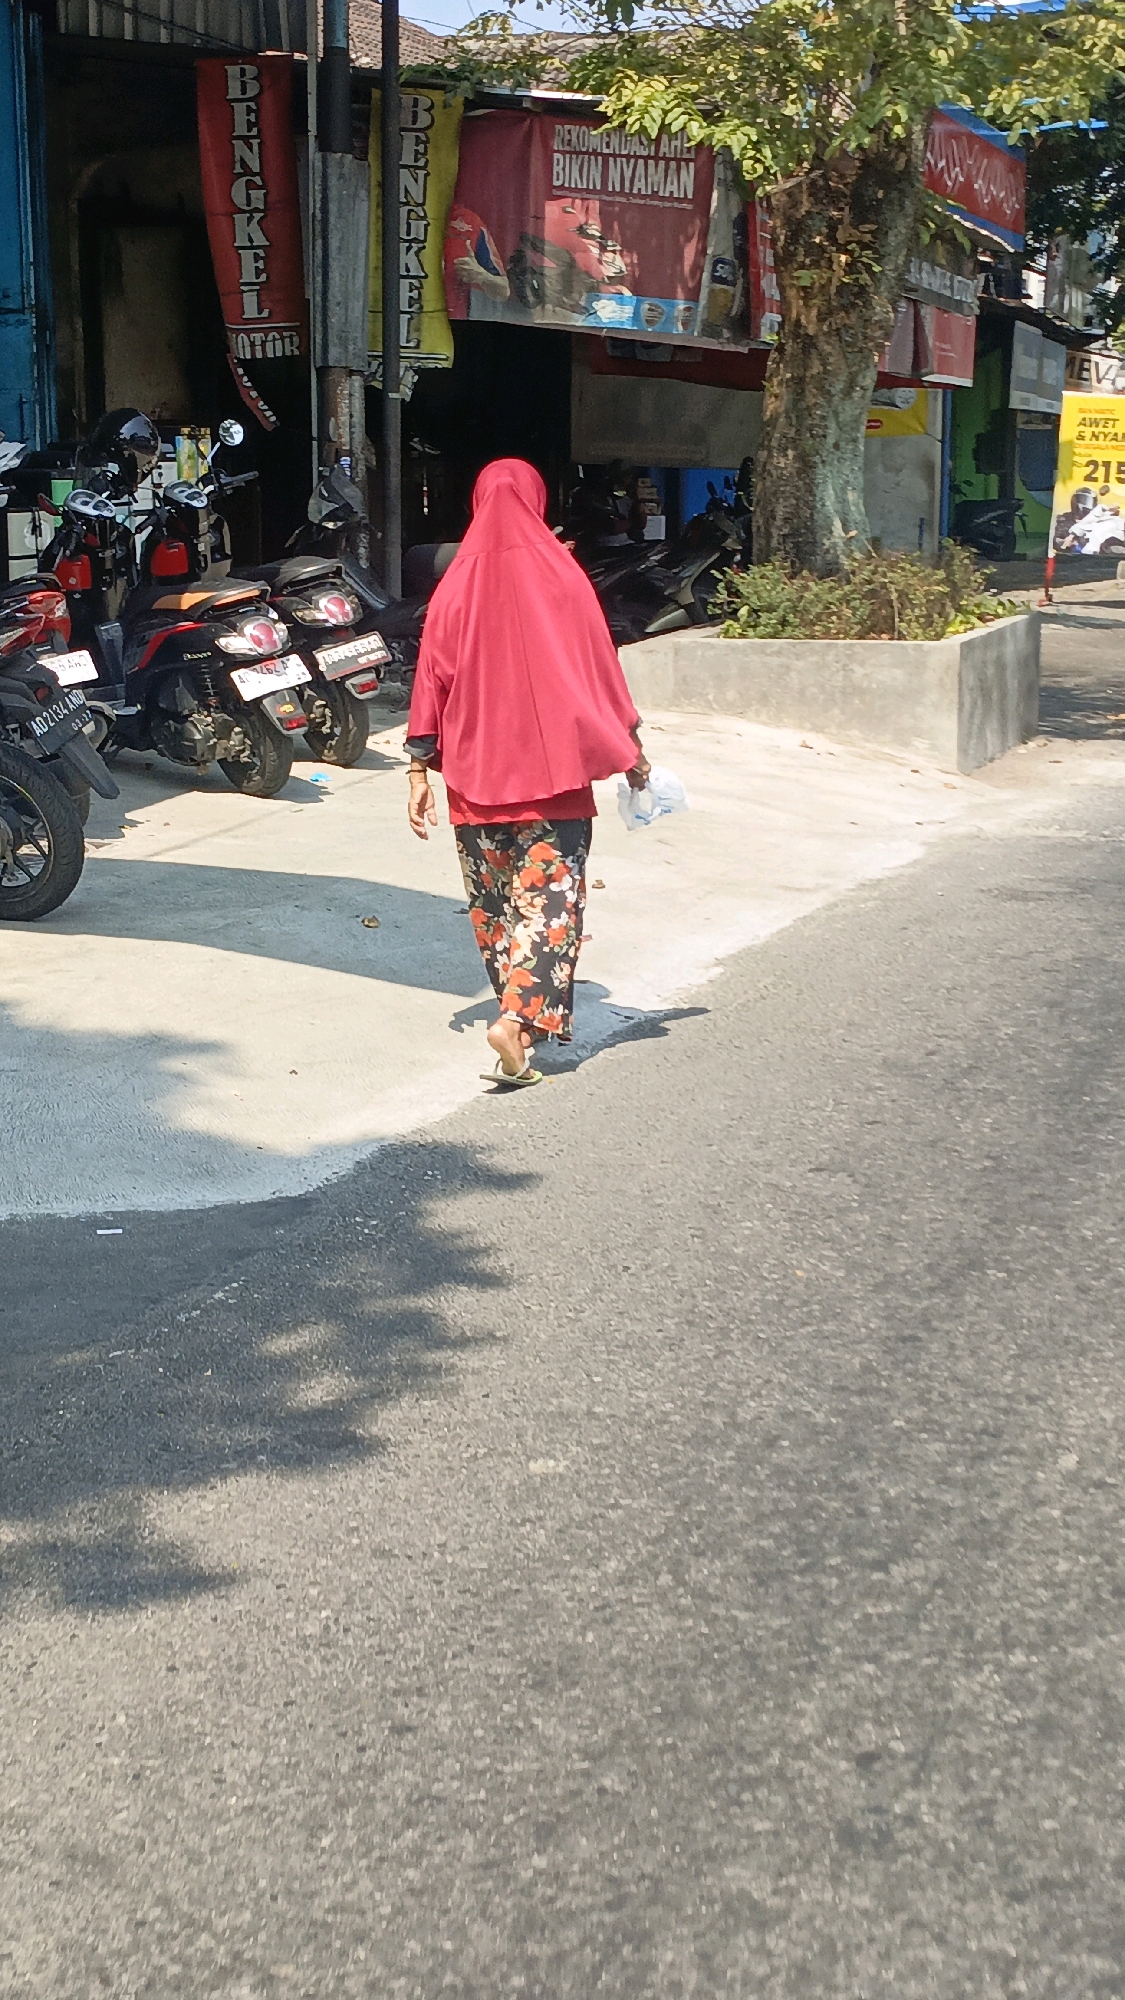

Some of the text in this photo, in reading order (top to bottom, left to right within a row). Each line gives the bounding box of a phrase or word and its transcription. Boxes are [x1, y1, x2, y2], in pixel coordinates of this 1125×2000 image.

[224, 63, 270, 320] BENGKEL
[552, 153, 695, 199] BIKIN NYAMAN
[399, 93, 433, 348] BENGKEL
[1075, 430, 1087, 441] &
[1077, 416, 1120, 429] AWET
[31, 716, 49, 737] AD
[43, 701, 69, 726] 2134
